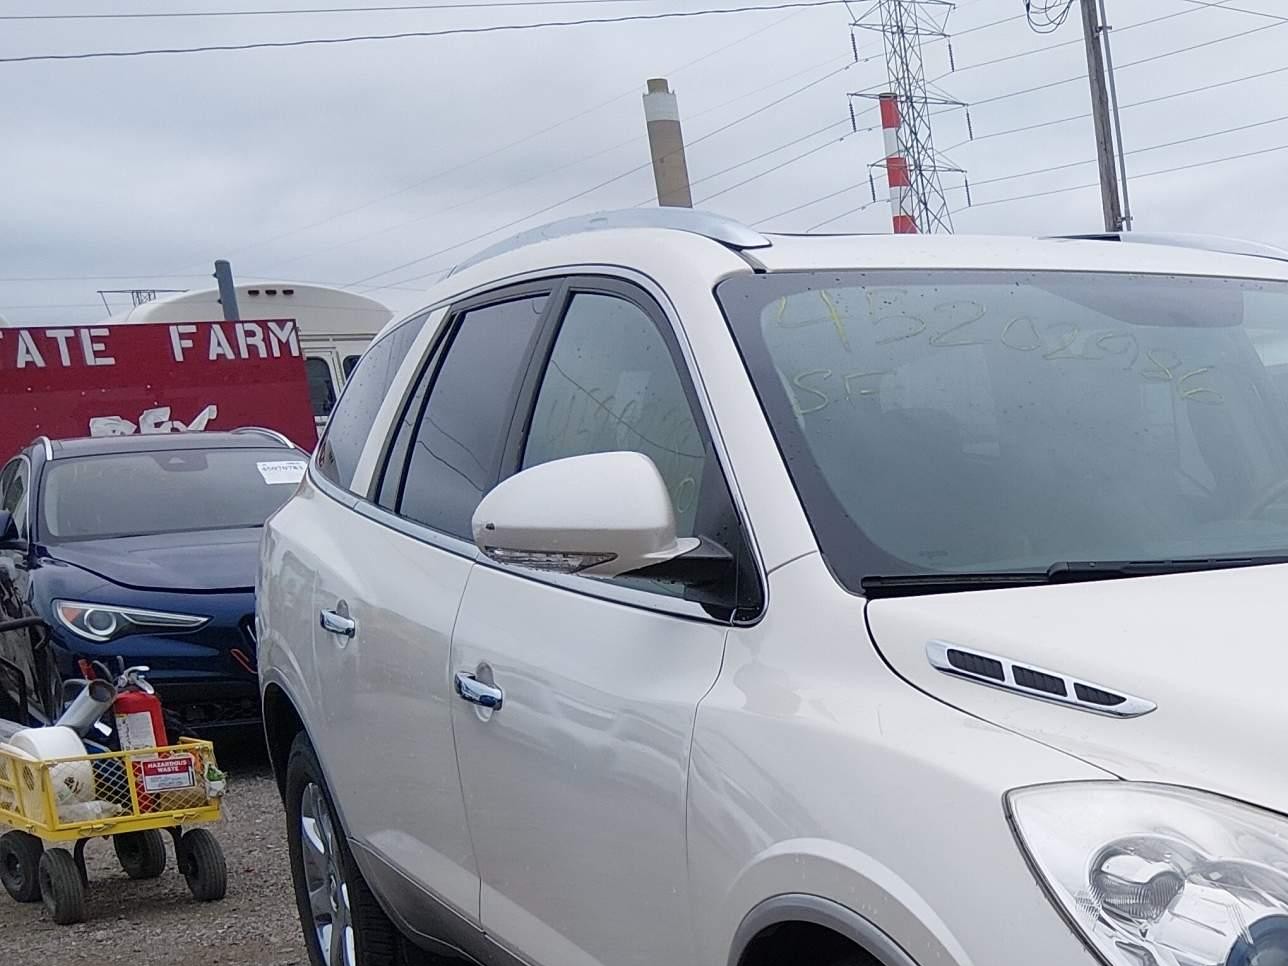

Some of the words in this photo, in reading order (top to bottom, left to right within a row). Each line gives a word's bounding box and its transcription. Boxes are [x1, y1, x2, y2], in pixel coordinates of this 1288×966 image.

[0, 328, 115, 368] ATE
[169, 321, 301, 362] FARM
[793, 368, 895, 417] SF
[147, 760, 188, 769] HAZARDOUS
[157, 765, 179, 773] WASTE
